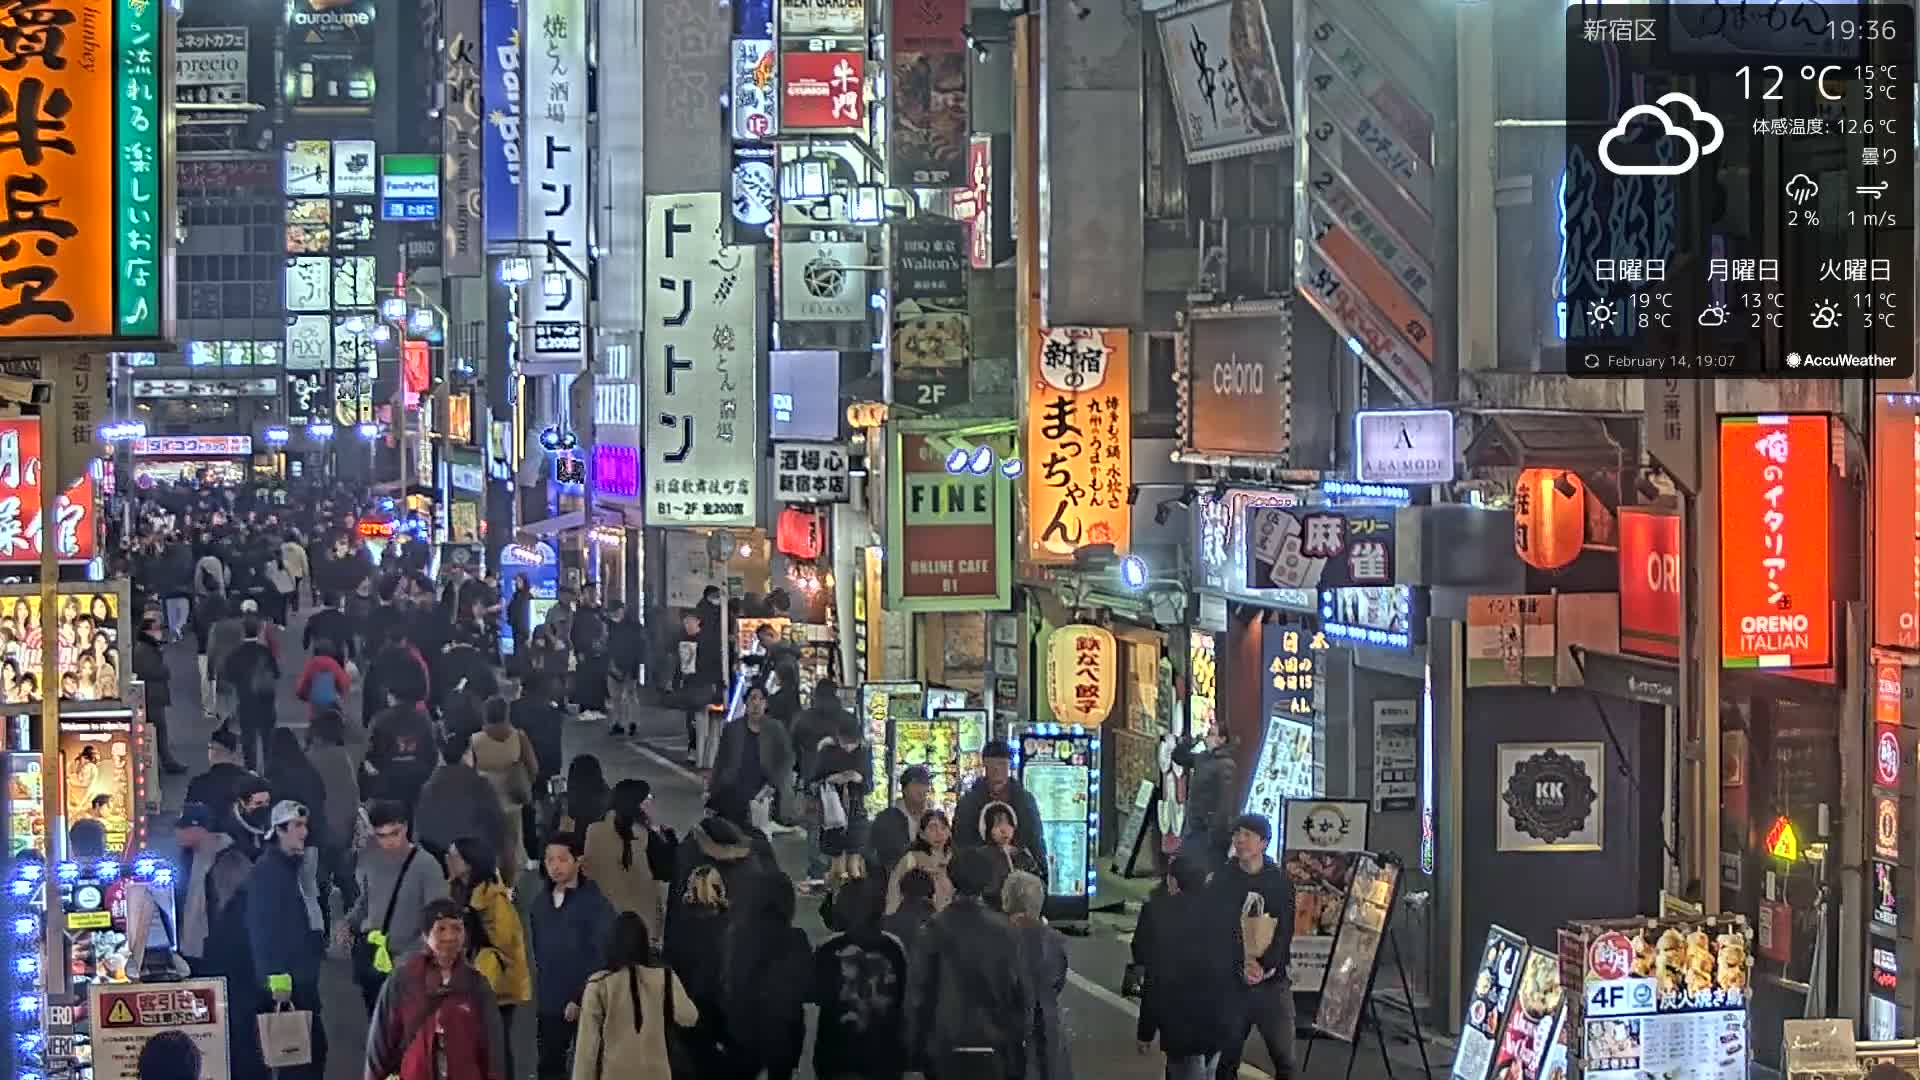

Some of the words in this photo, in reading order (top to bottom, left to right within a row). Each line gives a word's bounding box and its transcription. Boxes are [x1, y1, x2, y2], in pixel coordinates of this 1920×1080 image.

[296, 12, 369, 25] auralume
[1314, 22, 1335, 41] 5
[809, 39, 837, 51] 2F
[180, 55, 239, 76] precio
[543, 14, 569, 124] 焼とん酒場
[832, 58, 859, 121] 牛門
[1314, 122, 1334, 142] 3
[387, 182, 436, 192] FamilyMart
[1313, 172, 1334, 192] 2
[902, 254, 959, 271] Walton's
[656, 207, 692, 462] トントン
[1213, 357, 1264, 395] celona
[917, 384, 946, 405] 2F
[1393, 421, 1414, 449] A
[780, 450, 843, 472] 酒場心
[1041, 395, 1086, 546] まっちゃん
[779, 474, 844, 493] 新宿本店
[911, 485, 986, 513] FINE
[1350, 519, 1390, 535] フリー
[1753, 430, 1790, 604] 俺のイタリアン
[911, 560, 954, 575] ONLINE
[959, 560, 989, 574] CAFE
[1741, 613, 1809, 634] ORENO
[1740, 634, 1809, 653] ITALIAN
[1075, 635, 1102, 714] 鉄なべ餃子
[1536, 781, 1564, 799] KK
[1592, 986, 1625, 1008] 4F
